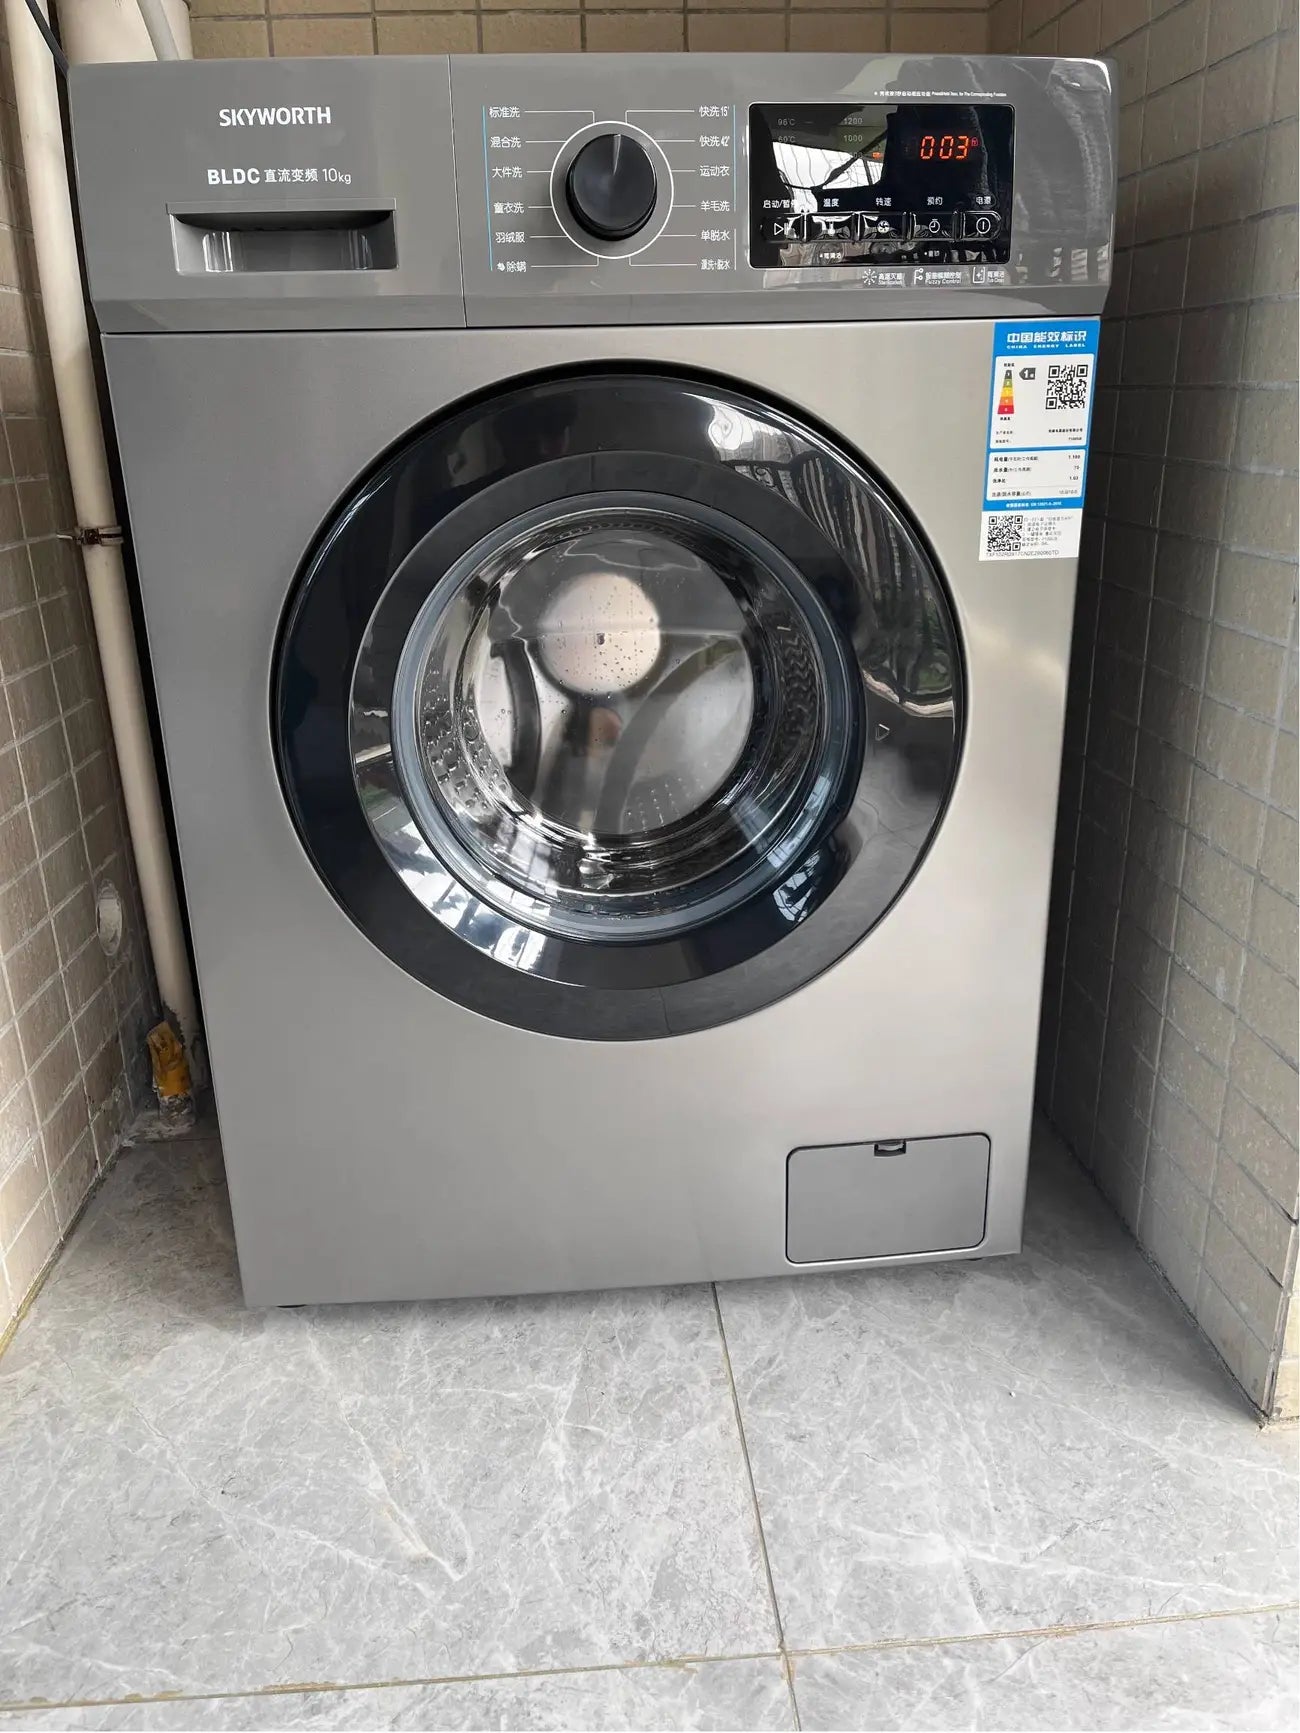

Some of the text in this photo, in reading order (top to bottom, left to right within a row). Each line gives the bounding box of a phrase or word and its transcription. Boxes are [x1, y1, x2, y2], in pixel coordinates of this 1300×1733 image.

[219, 106, 332, 127] SKYWORTH
[488, 106, 520, 118] 标准洗
[490, 136, 522, 148] 混合洗
[920, 136, 969, 160] 003
[207, 168, 352, 185] BLDC 直流变频 10kg
[492, 166, 522, 178] 大件洗
[699, 165, 730, 177] 运动衣
[700, 200, 730, 212] 羊毛洗
[823, 198, 840, 208] 温度
[875, 196, 892, 207] 转速
[926, 196, 943, 206] 预约
[975, 196, 992, 206] 电源
[494, 202, 524, 214] 童衣洗
[494, 231, 526, 244] 羽绒服
[700, 230, 730, 242] 单脱水
[506, 261, 527, 273] 除螨
[1006, 330, 1086, 344] 中国能效标识
